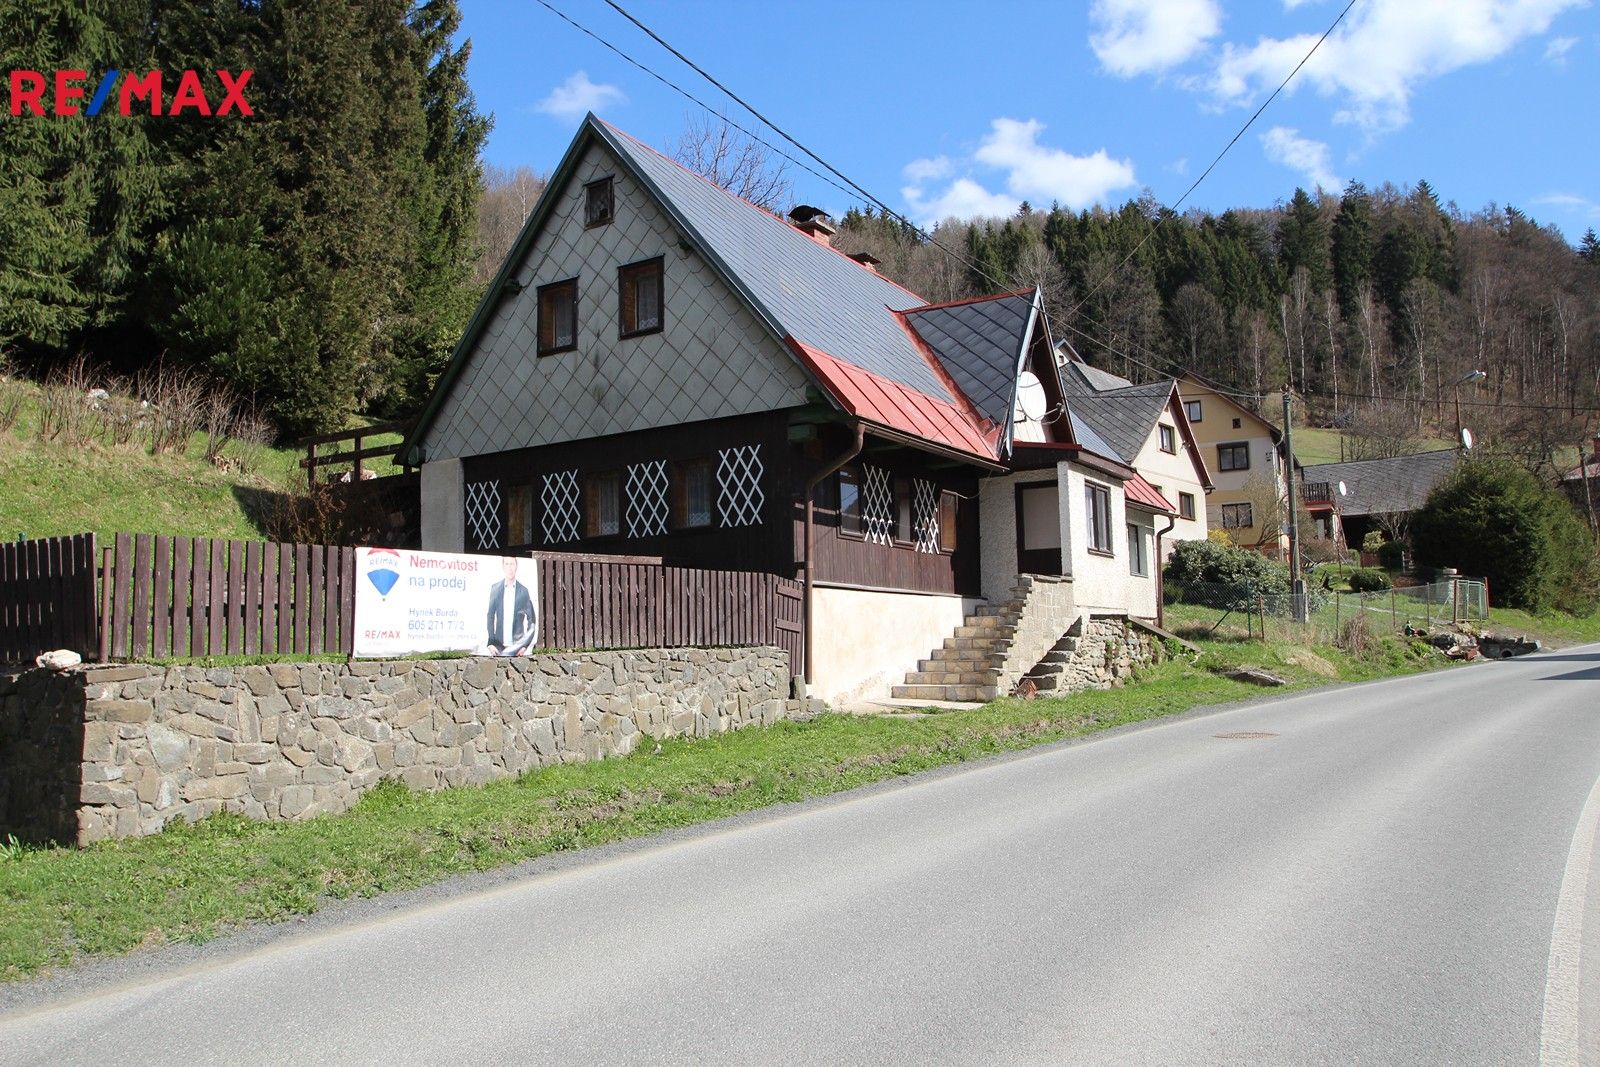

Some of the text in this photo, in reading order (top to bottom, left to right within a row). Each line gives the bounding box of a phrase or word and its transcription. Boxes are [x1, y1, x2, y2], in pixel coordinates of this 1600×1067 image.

[409, 554, 478, 572] Nemovitost
[409, 576, 467, 591] na prodej
[408, 607, 458, 617] Hynek Burda
[408, 619, 426, 630] 605
[428, 619, 444, 630] 271
[364, 630, 401, 639] RE/MAX
